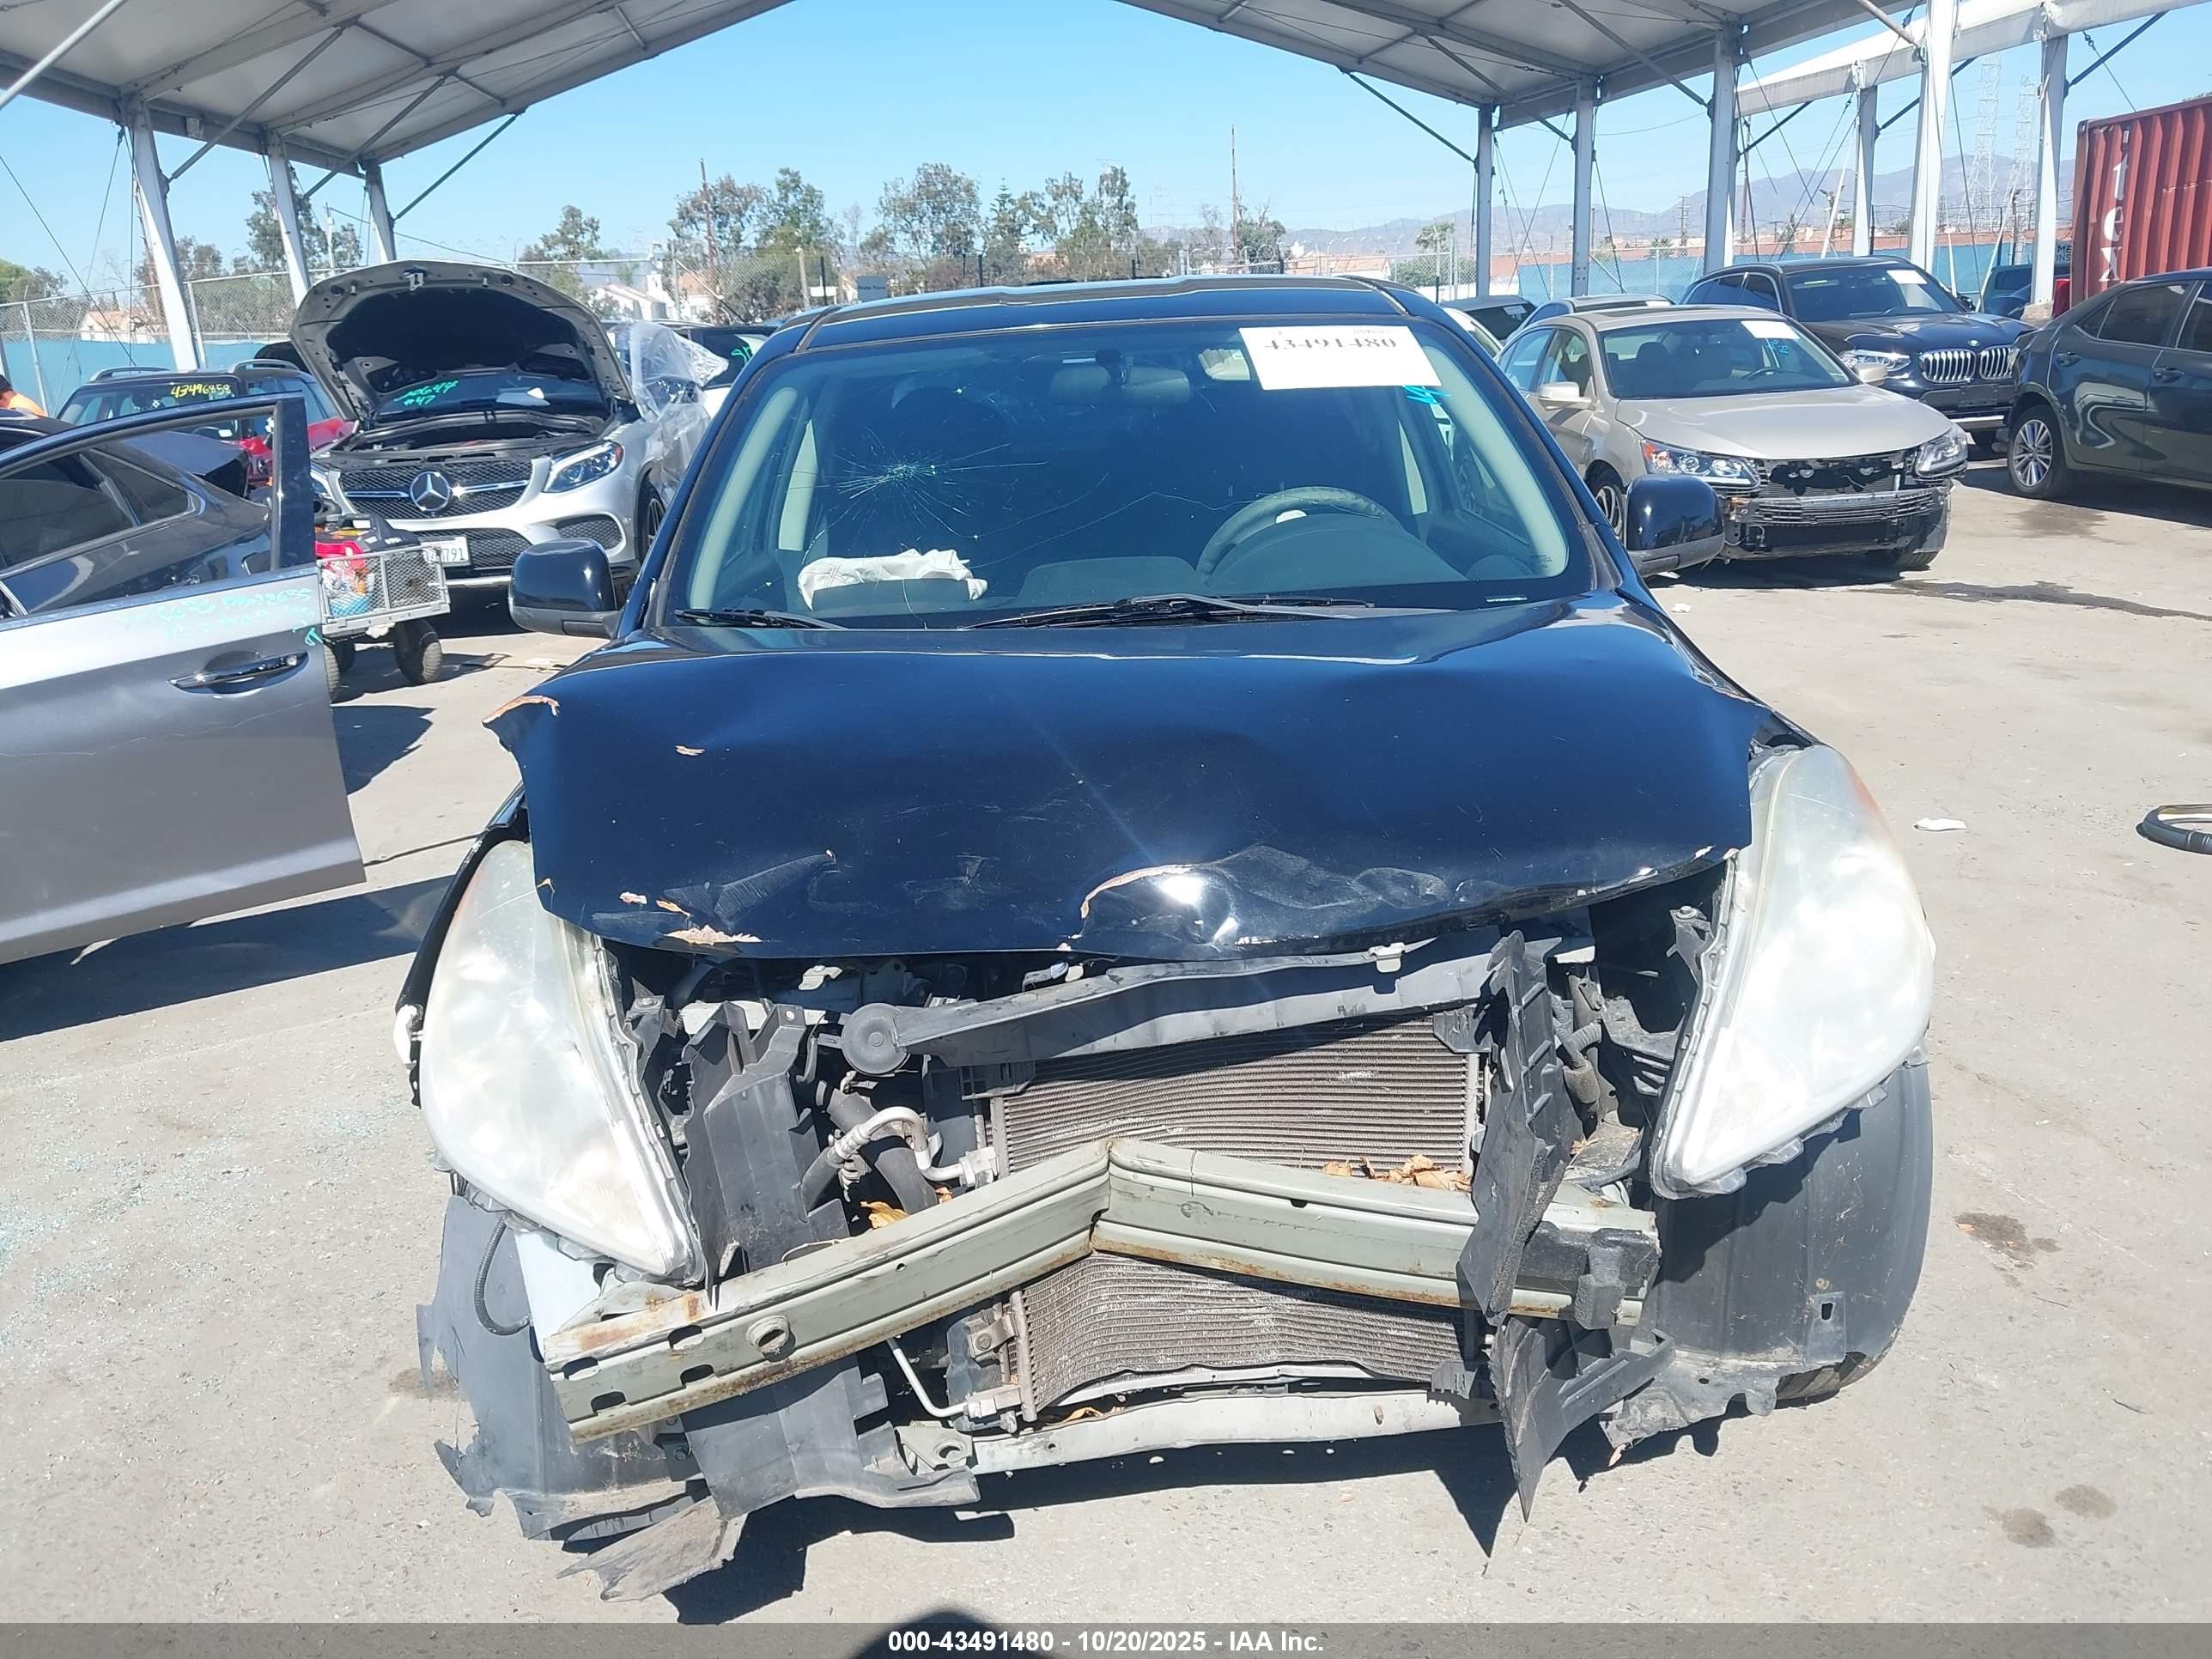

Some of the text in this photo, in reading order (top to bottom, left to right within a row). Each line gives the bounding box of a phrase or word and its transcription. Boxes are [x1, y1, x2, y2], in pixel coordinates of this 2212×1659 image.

[2099, 153, 2129, 282] tex
[1264, 337, 1397, 350] 43491480
[170, 383, 232, 399] 43496858
